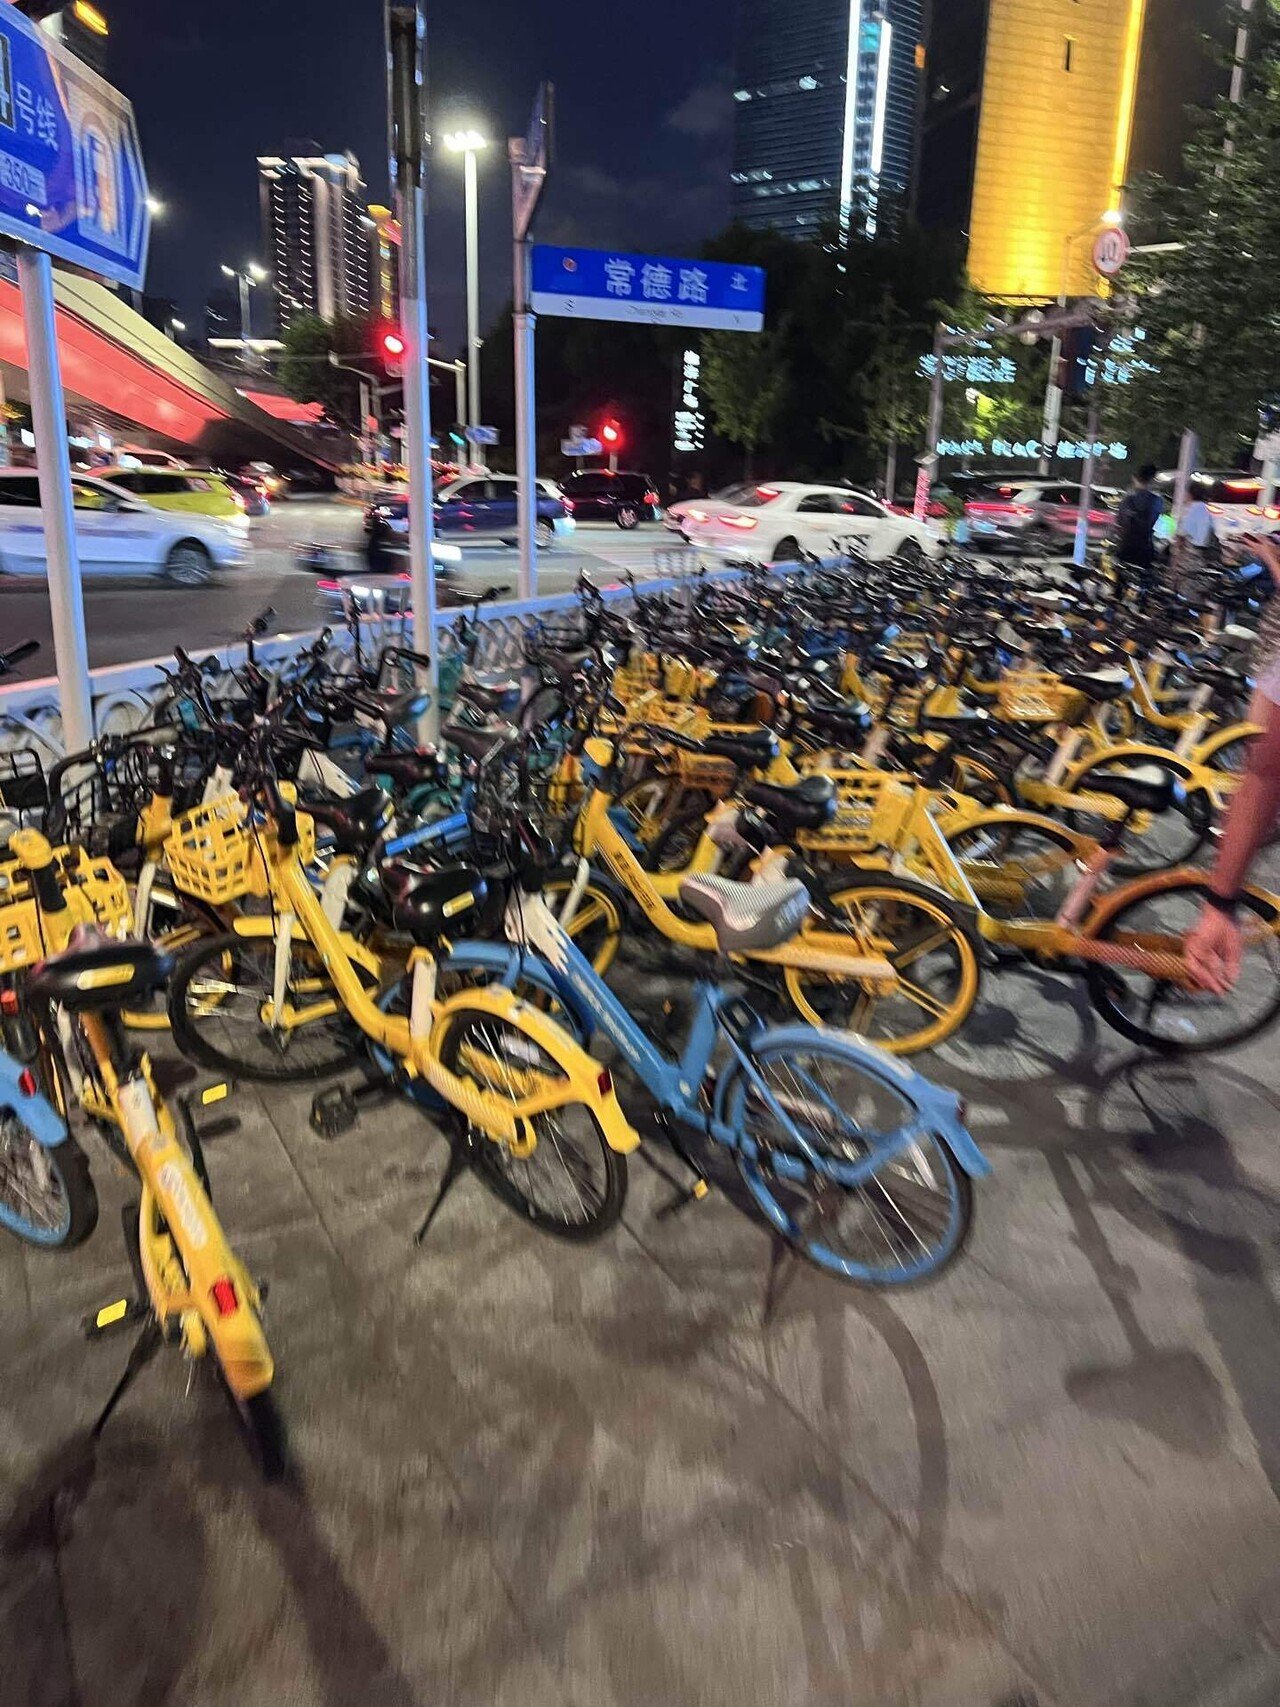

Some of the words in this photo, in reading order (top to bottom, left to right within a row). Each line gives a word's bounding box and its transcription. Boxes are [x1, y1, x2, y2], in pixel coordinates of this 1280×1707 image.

[15, 81, 59, 151] 号线
[604, 257, 709, 304] 常德路
